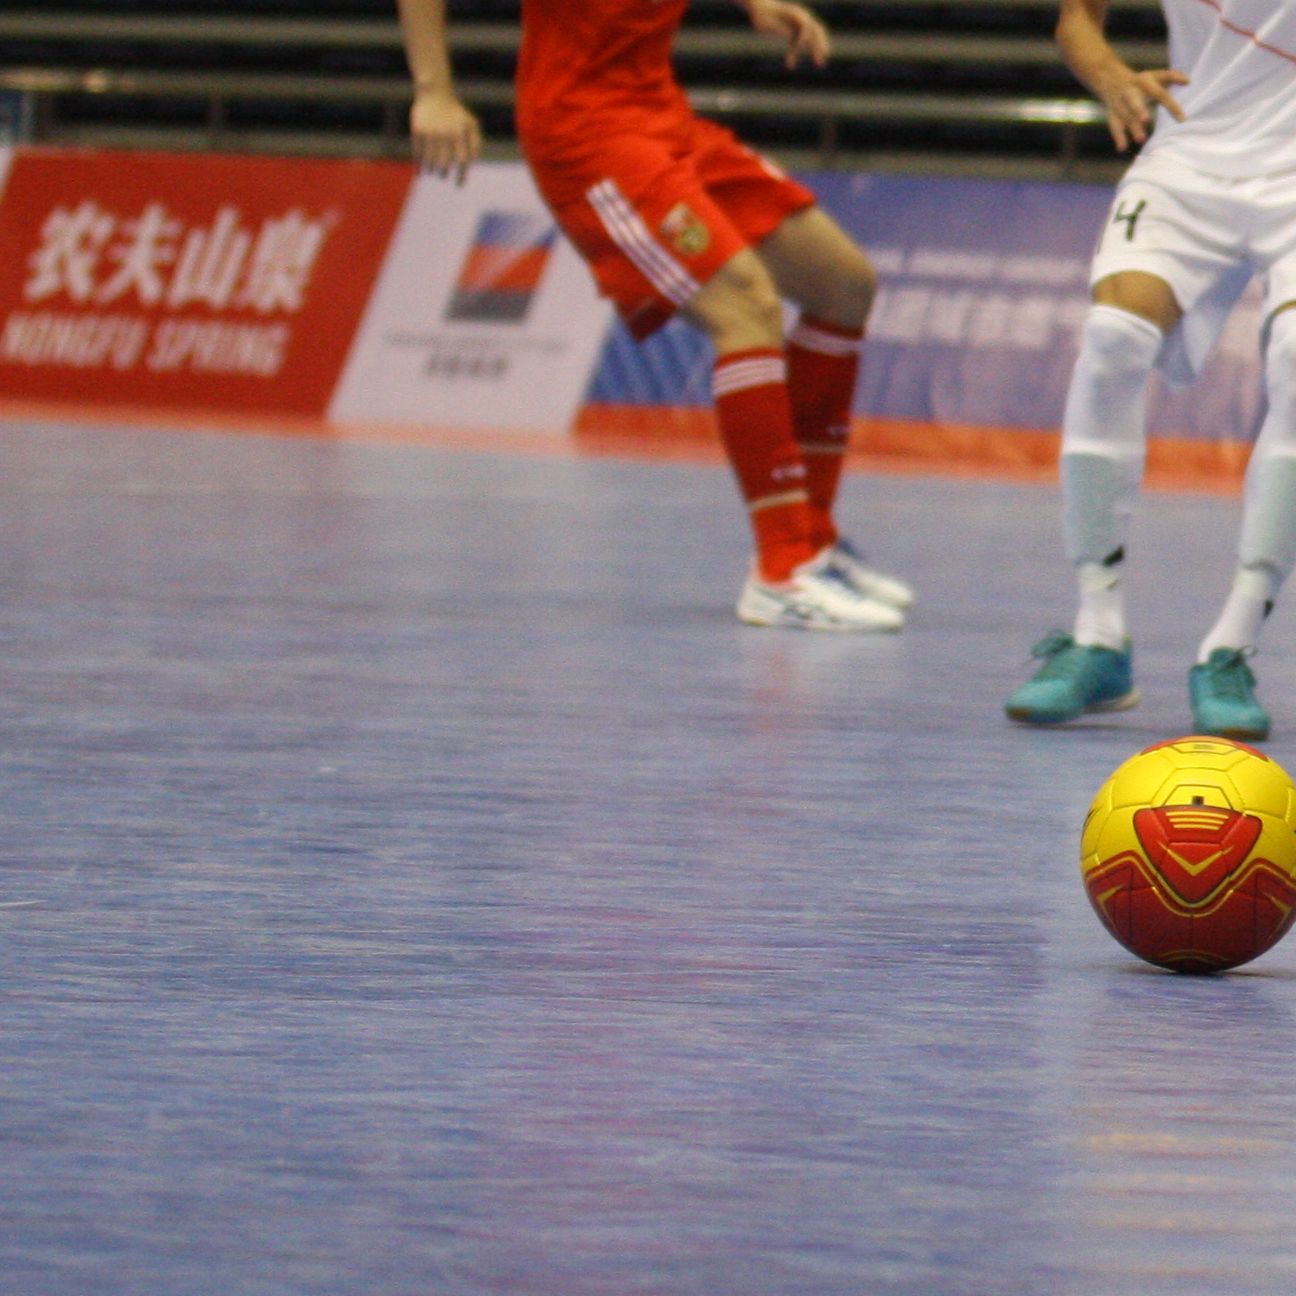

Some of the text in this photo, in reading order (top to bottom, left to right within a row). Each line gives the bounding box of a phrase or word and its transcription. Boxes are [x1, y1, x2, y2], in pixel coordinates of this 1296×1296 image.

[20, 200, 326, 314] 农夫山泉
[146, 318, 292, 378] SPRING
